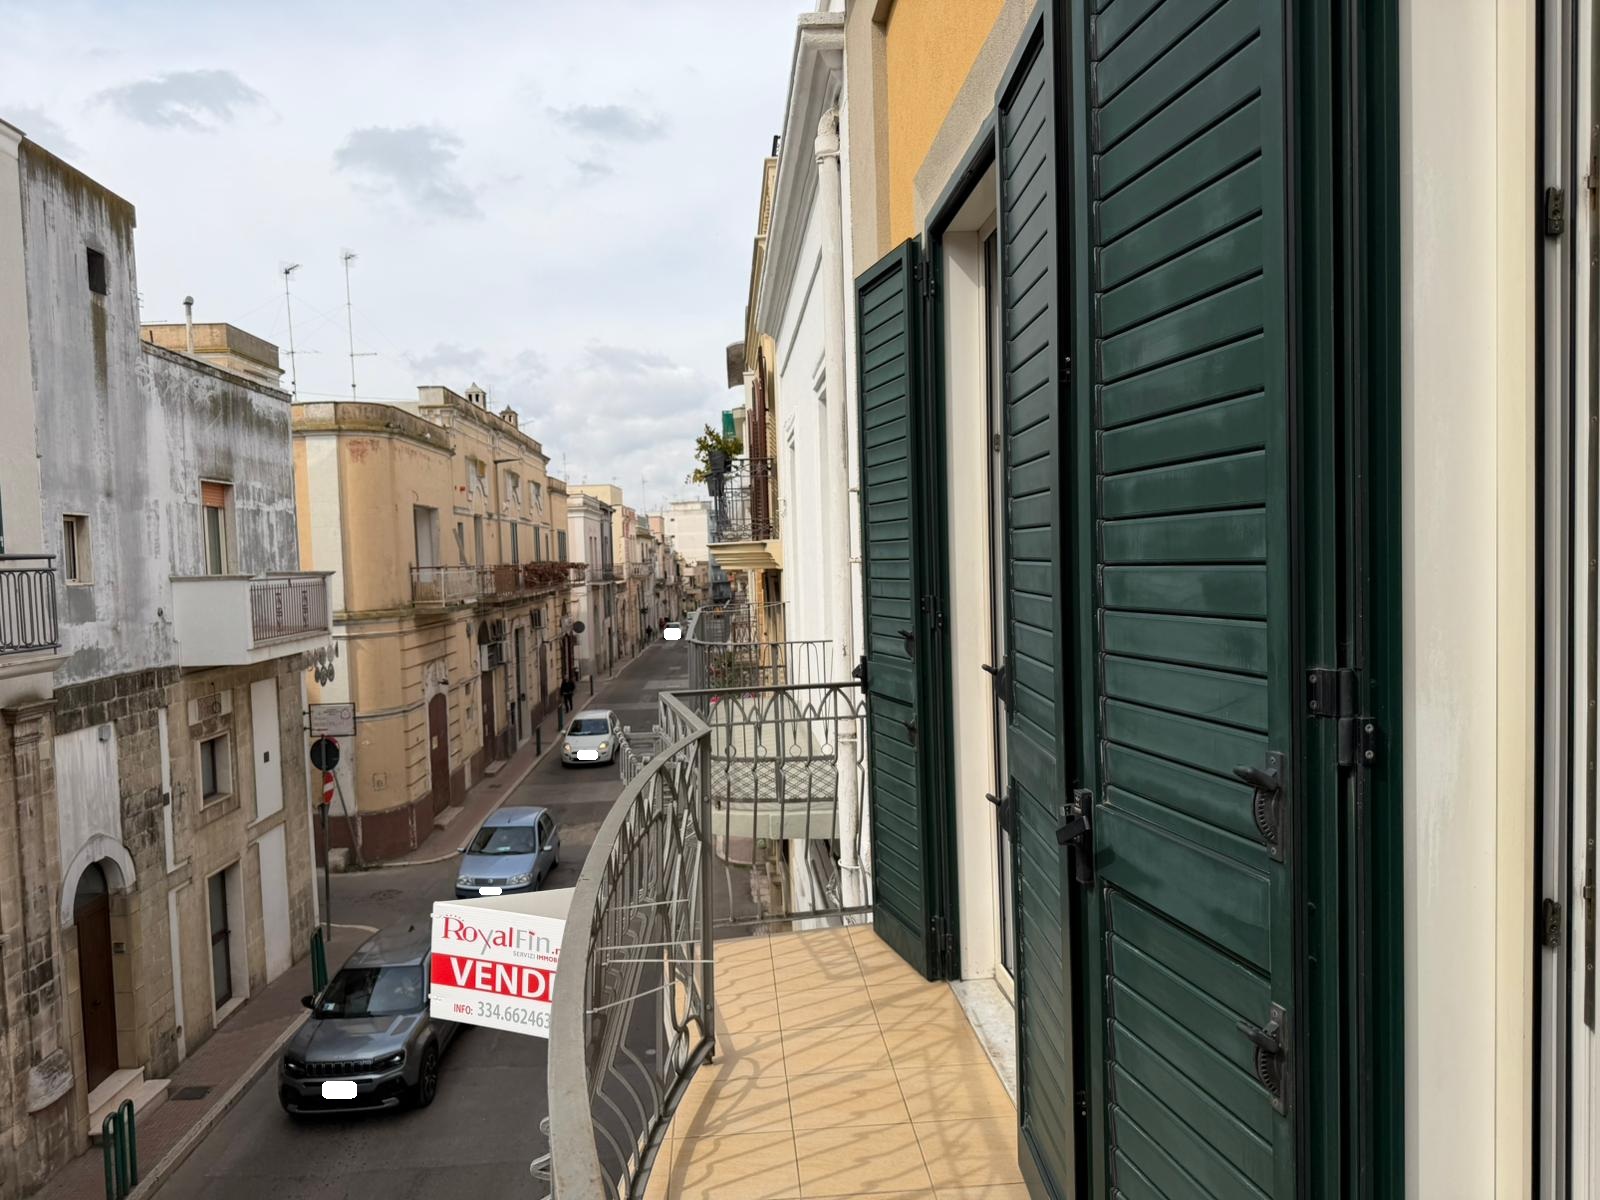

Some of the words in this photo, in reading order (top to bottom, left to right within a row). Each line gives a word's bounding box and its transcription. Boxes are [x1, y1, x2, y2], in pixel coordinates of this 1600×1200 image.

[513, 950, 536, 960] SERVIZI
[537, 954, 560, 963] IMMOB
[453, 1003, 473, 1015] INFO:
